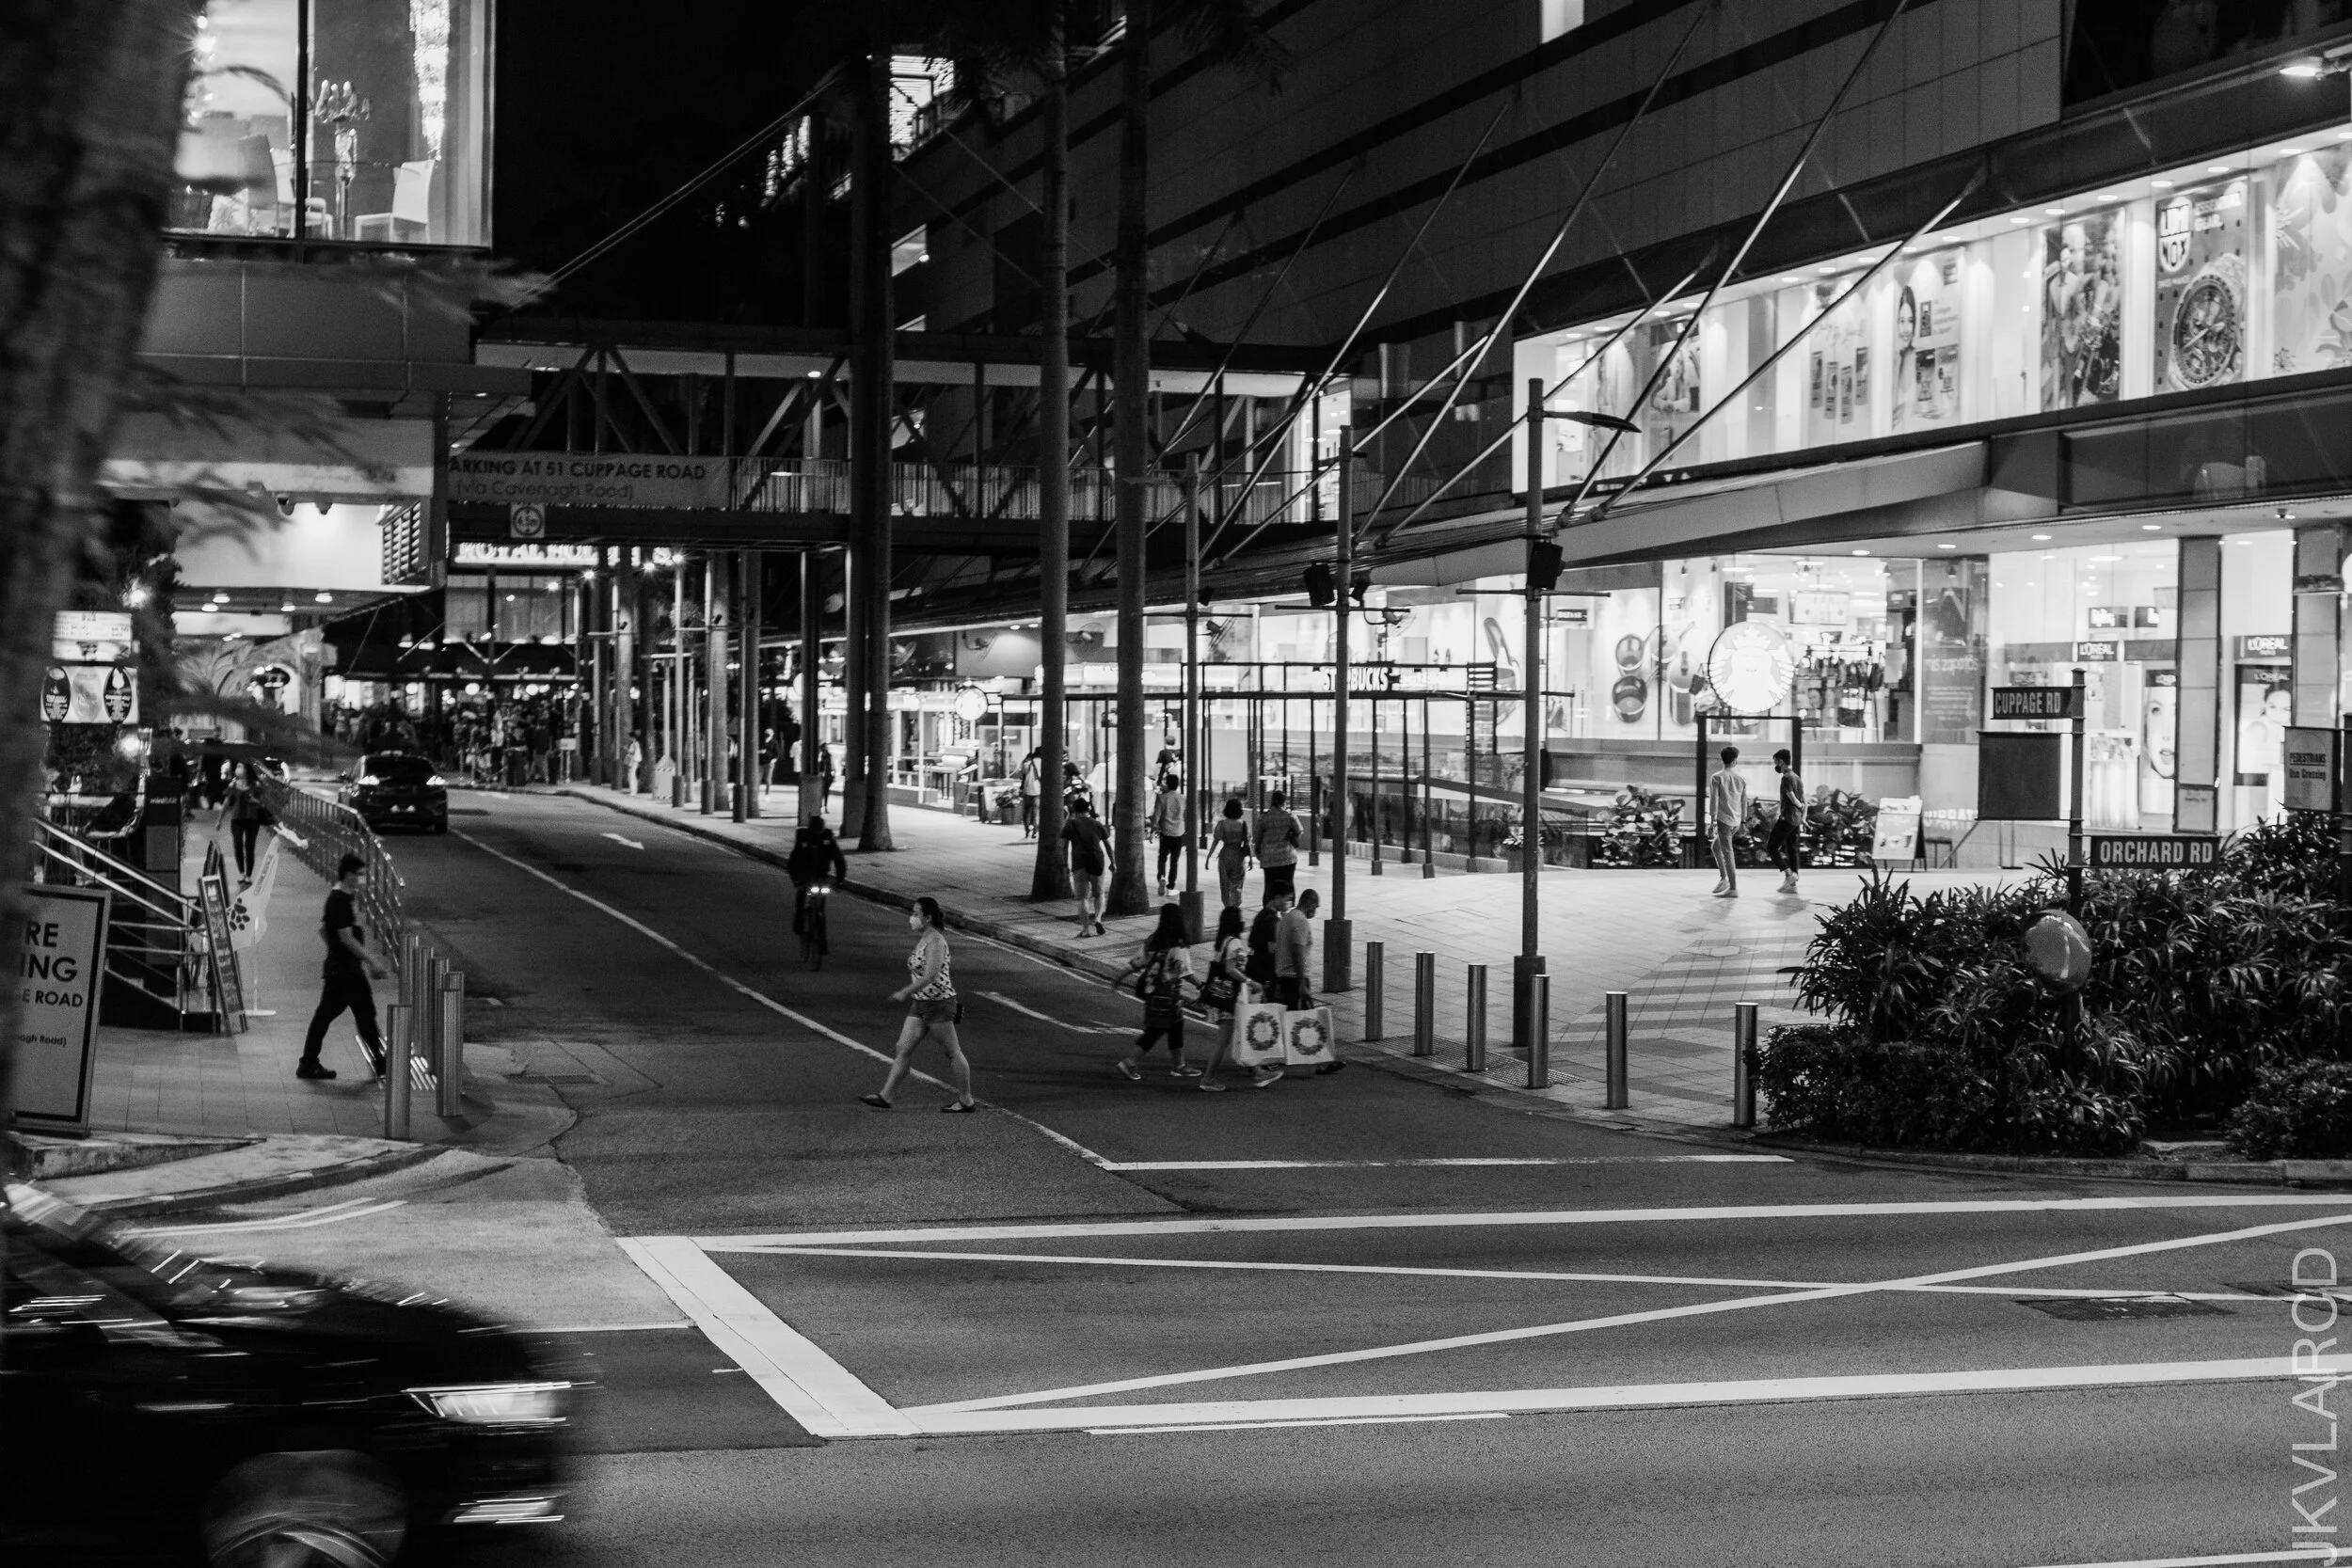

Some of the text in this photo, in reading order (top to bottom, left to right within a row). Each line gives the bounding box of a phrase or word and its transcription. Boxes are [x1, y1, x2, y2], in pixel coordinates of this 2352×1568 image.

[520, 461, 541, 475] AT
[546, 461, 564, 476] 51
[569, 462, 652, 479] CUPPAGE
[656, 464, 707, 481] ROAD
[1323, 667, 1389, 692] STBUCKS
[1994, 692, 2042, 714] CUPPAGE
[2046, 691, 2061, 713] RD
[2289, 752, 2326, 764] PEDESTRIANS
[2100, 841, 2213, 863] ORCHARD RD
[35, 990, 83, 1007] ROAD
